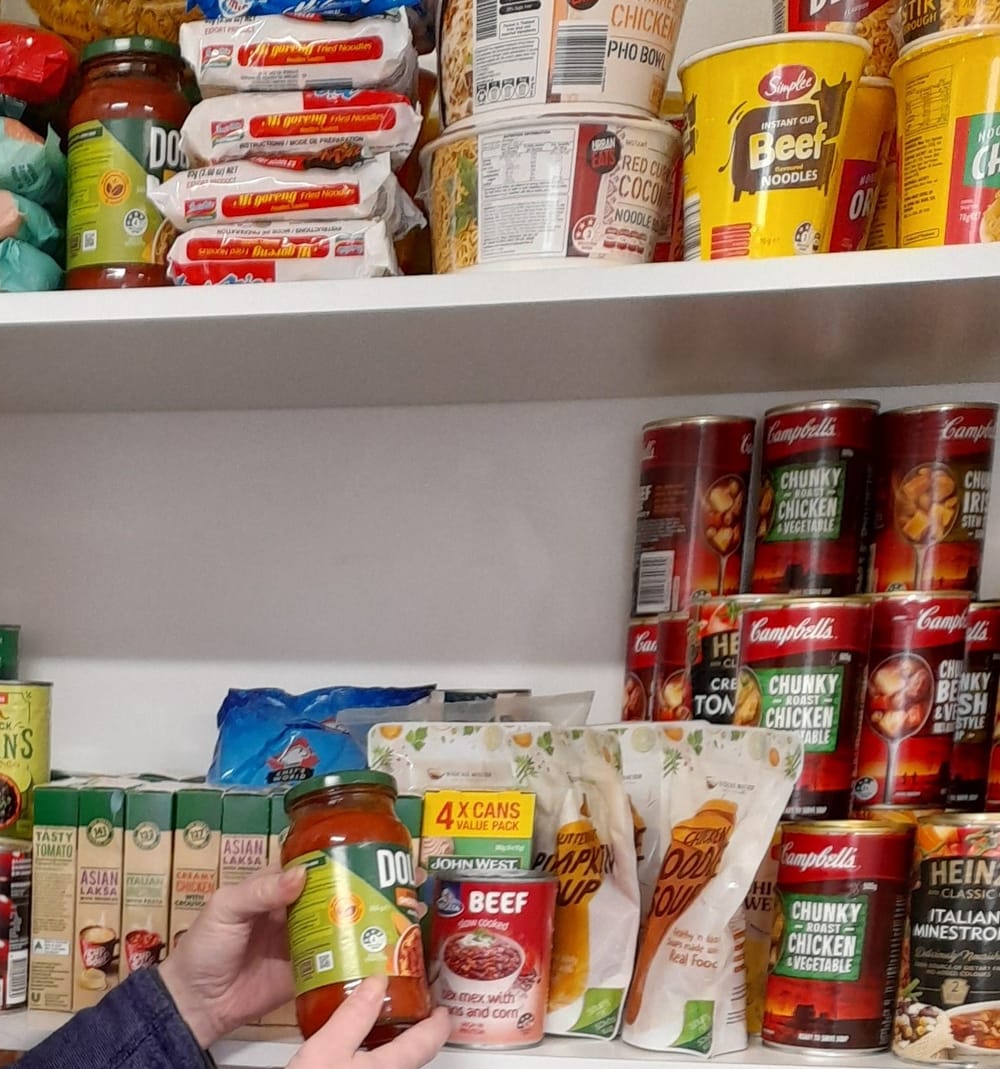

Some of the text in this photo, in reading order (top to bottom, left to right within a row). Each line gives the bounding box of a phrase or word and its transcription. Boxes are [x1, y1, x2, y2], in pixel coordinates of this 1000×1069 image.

[607, 39, 667, 72] PHO BOWL
[761, 115, 815, 131] INSTANT CUP
[750, 121, 828, 170] Beef
[622, 154, 648, 174] RED
[761, 169, 819, 187] NOODLES
[780, 467, 842, 490] CHUNKY
[778, 497, 838, 520] CHICKEN
[750, 616, 835, 647] Campbell's
[769, 674, 840, 695] CHUNKY
[786, 694, 819, 706] ROAST
[765, 707, 834, 729] CHICKEN
[436, 801, 521, 830] 4 X CANS
[456, 820, 519, 831] VALUE PACK
[36, 830, 73, 842] TASTY
[36, 844, 73, 858] TOMATO
[223, 839, 263, 854] ASIAN
[223, 857, 262, 865] LAKSA
[430, 858, 519, 871] JOHN WEST
[780, 841, 858, 871] Campbell's
[80, 870, 118, 886] ASIAN
[80, 887, 117, 896] LAKSA
[941, 888, 996, 900] CLASSIC
[468, 890, 530, 914] BEEF
[792, 901, 862, 923] CHUNKY
[806, 922, 841, 934] ROAST
[788, 932, 857, 956] CHICKEN
[793, 955, 853, 974] VEGETABLE
[487, 991, 516, 1004] with
[466, 1006, 519, 1019] and corn
